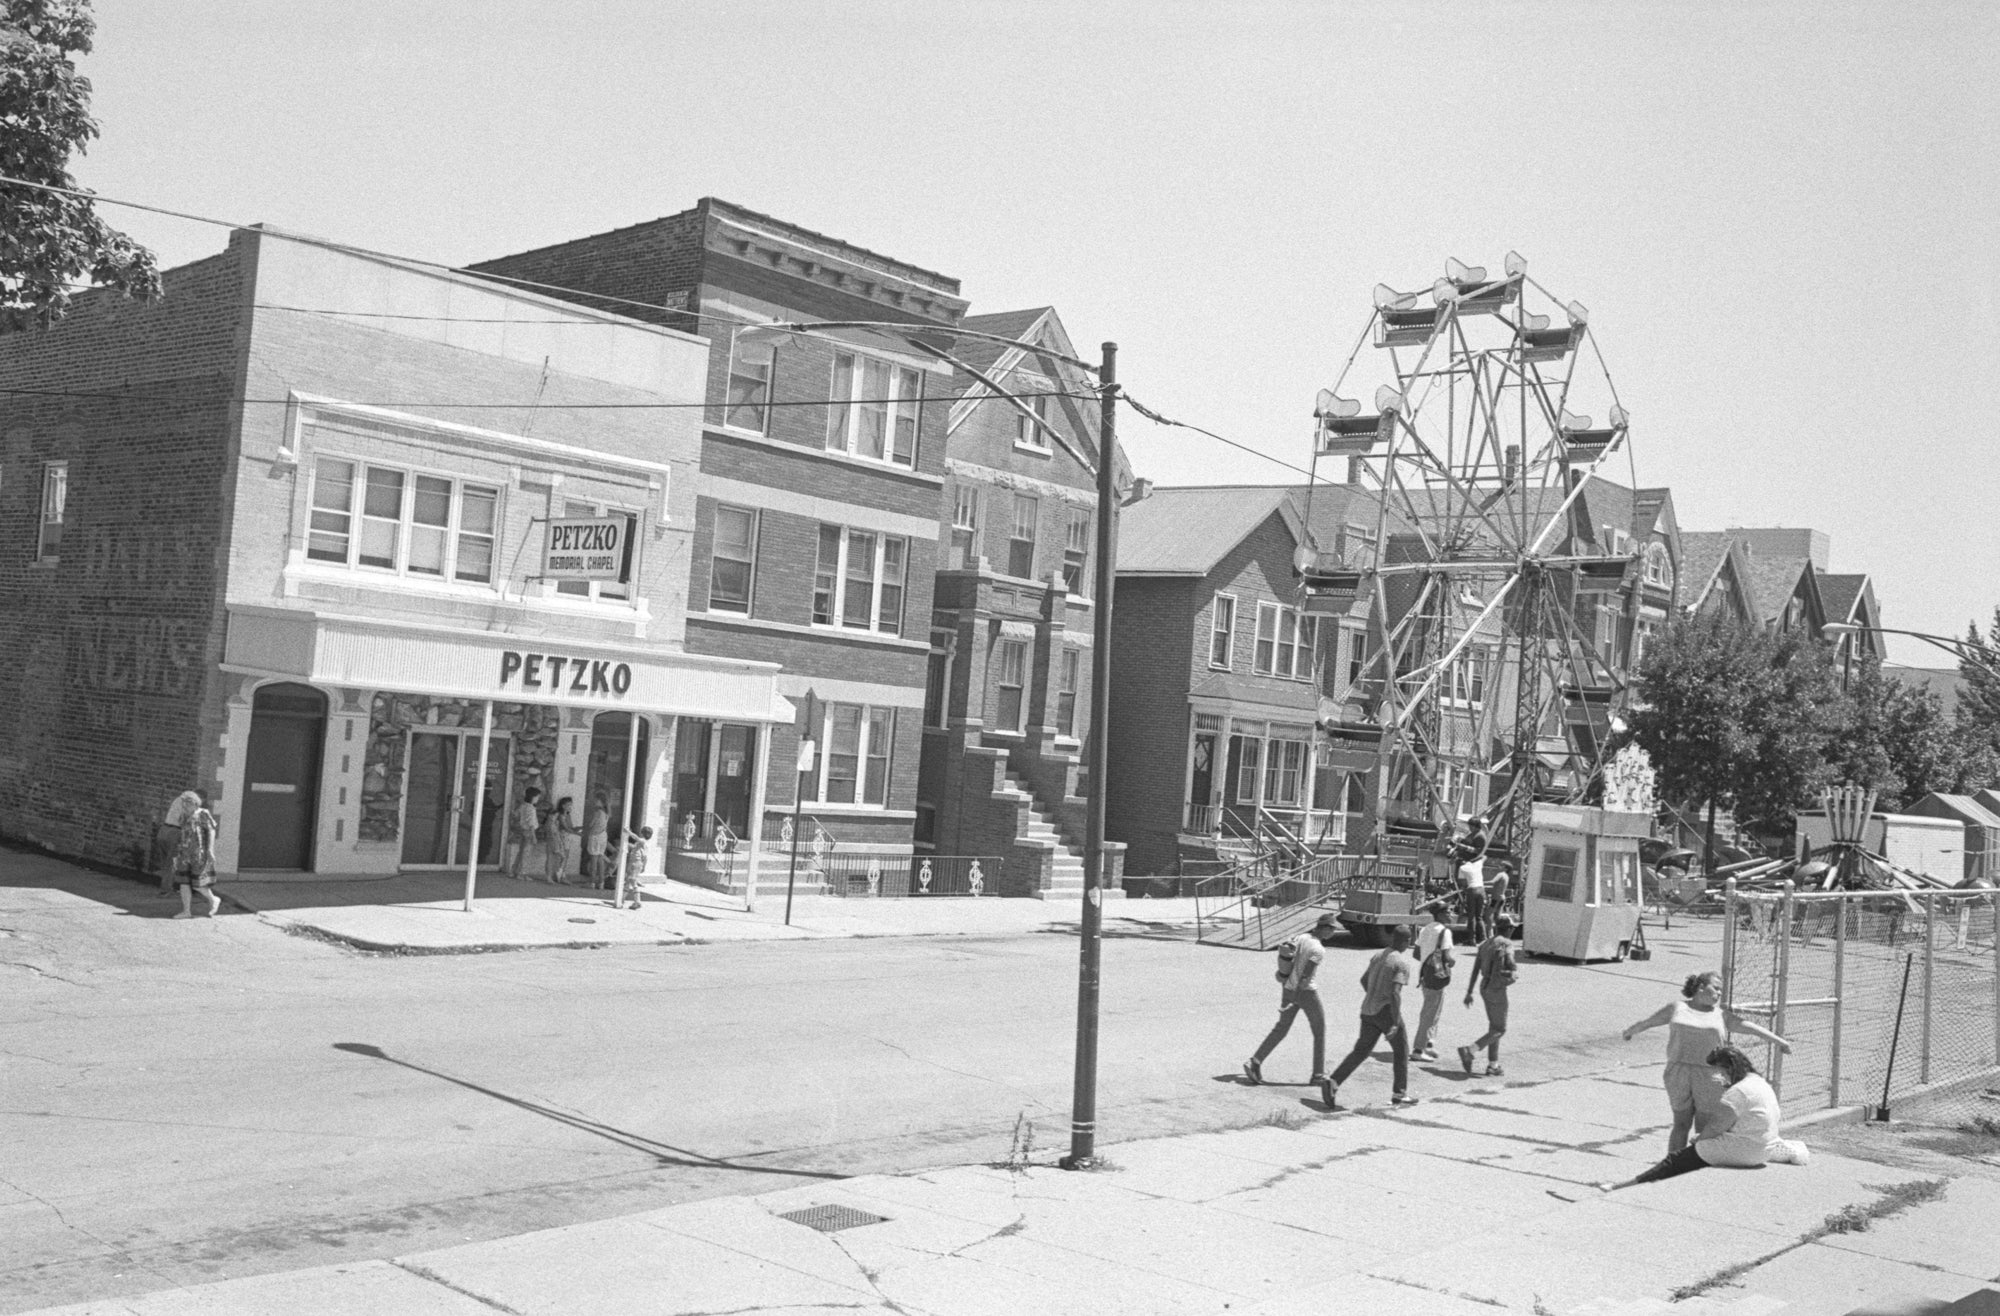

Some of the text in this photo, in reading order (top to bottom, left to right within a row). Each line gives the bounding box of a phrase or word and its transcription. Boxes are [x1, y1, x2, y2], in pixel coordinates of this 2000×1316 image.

[550, 524, 618, 551] PETZKO
[549, 556, 614, 570] MEMORIAL CHAPEL
[500, 651, 632, 694] PETZKO
